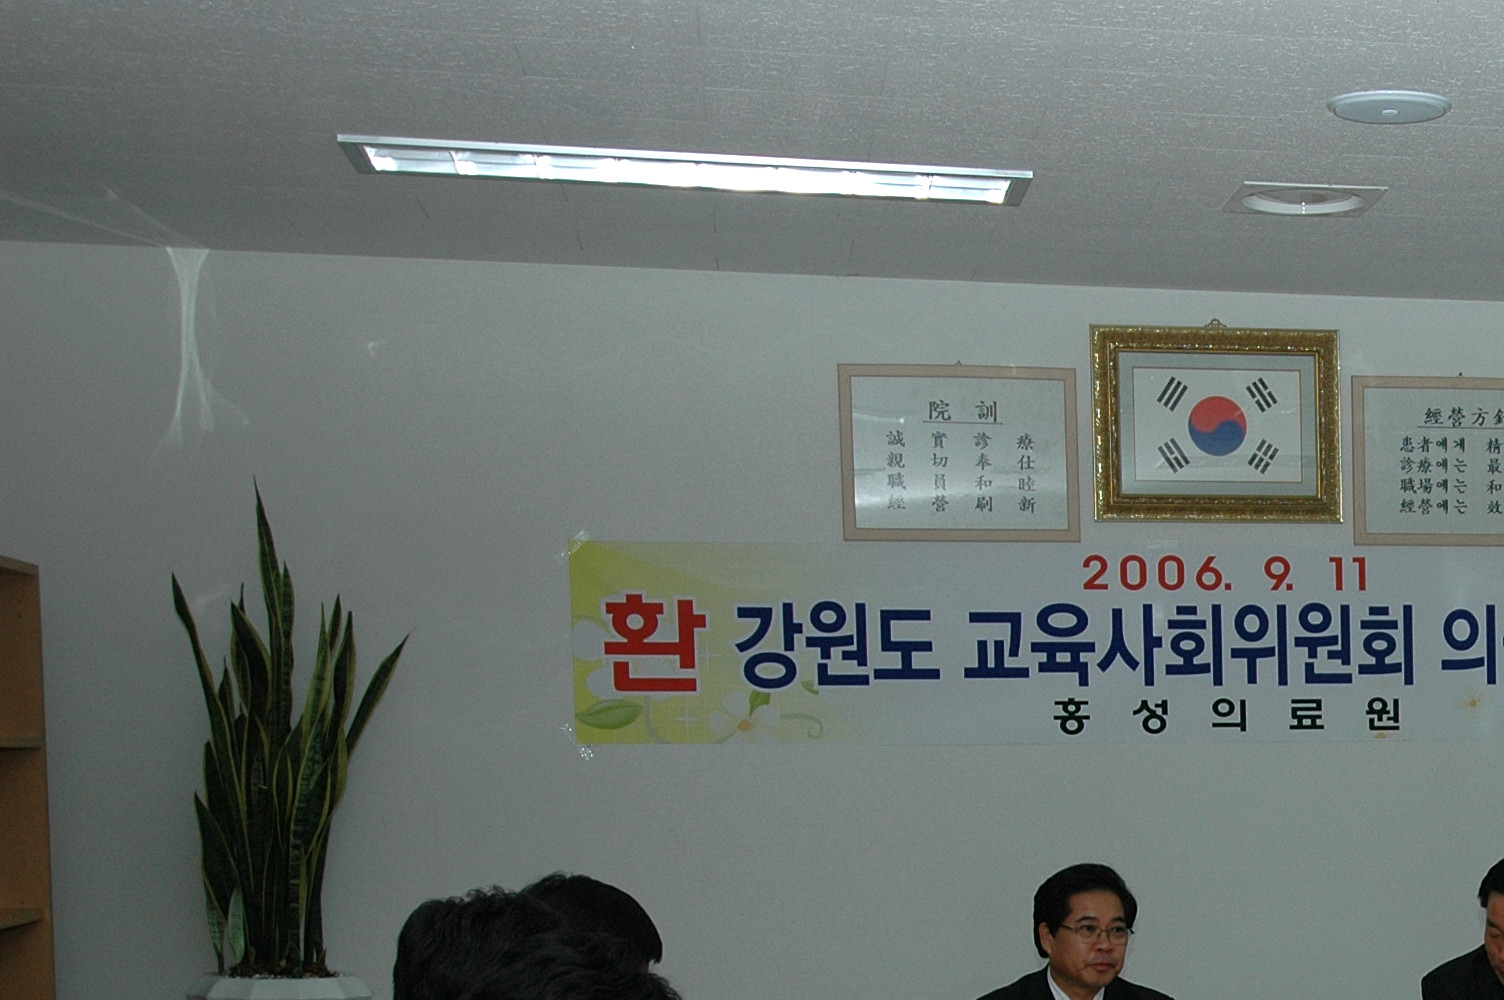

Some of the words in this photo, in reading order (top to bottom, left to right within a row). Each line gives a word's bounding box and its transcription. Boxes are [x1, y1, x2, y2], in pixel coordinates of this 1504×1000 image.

[1083, 554, 1233, 592] 2006.
[1263, 556, 1295, 591] 9.
[1329, 557, 1368, 591] 11
[603, 593, 707, 692] 환
[735, 600, 942, 690] 강원도
[963, 602, 1414, 688] 교육사회위원회
[1053, 698, 1400, 736] 홍성의료원
